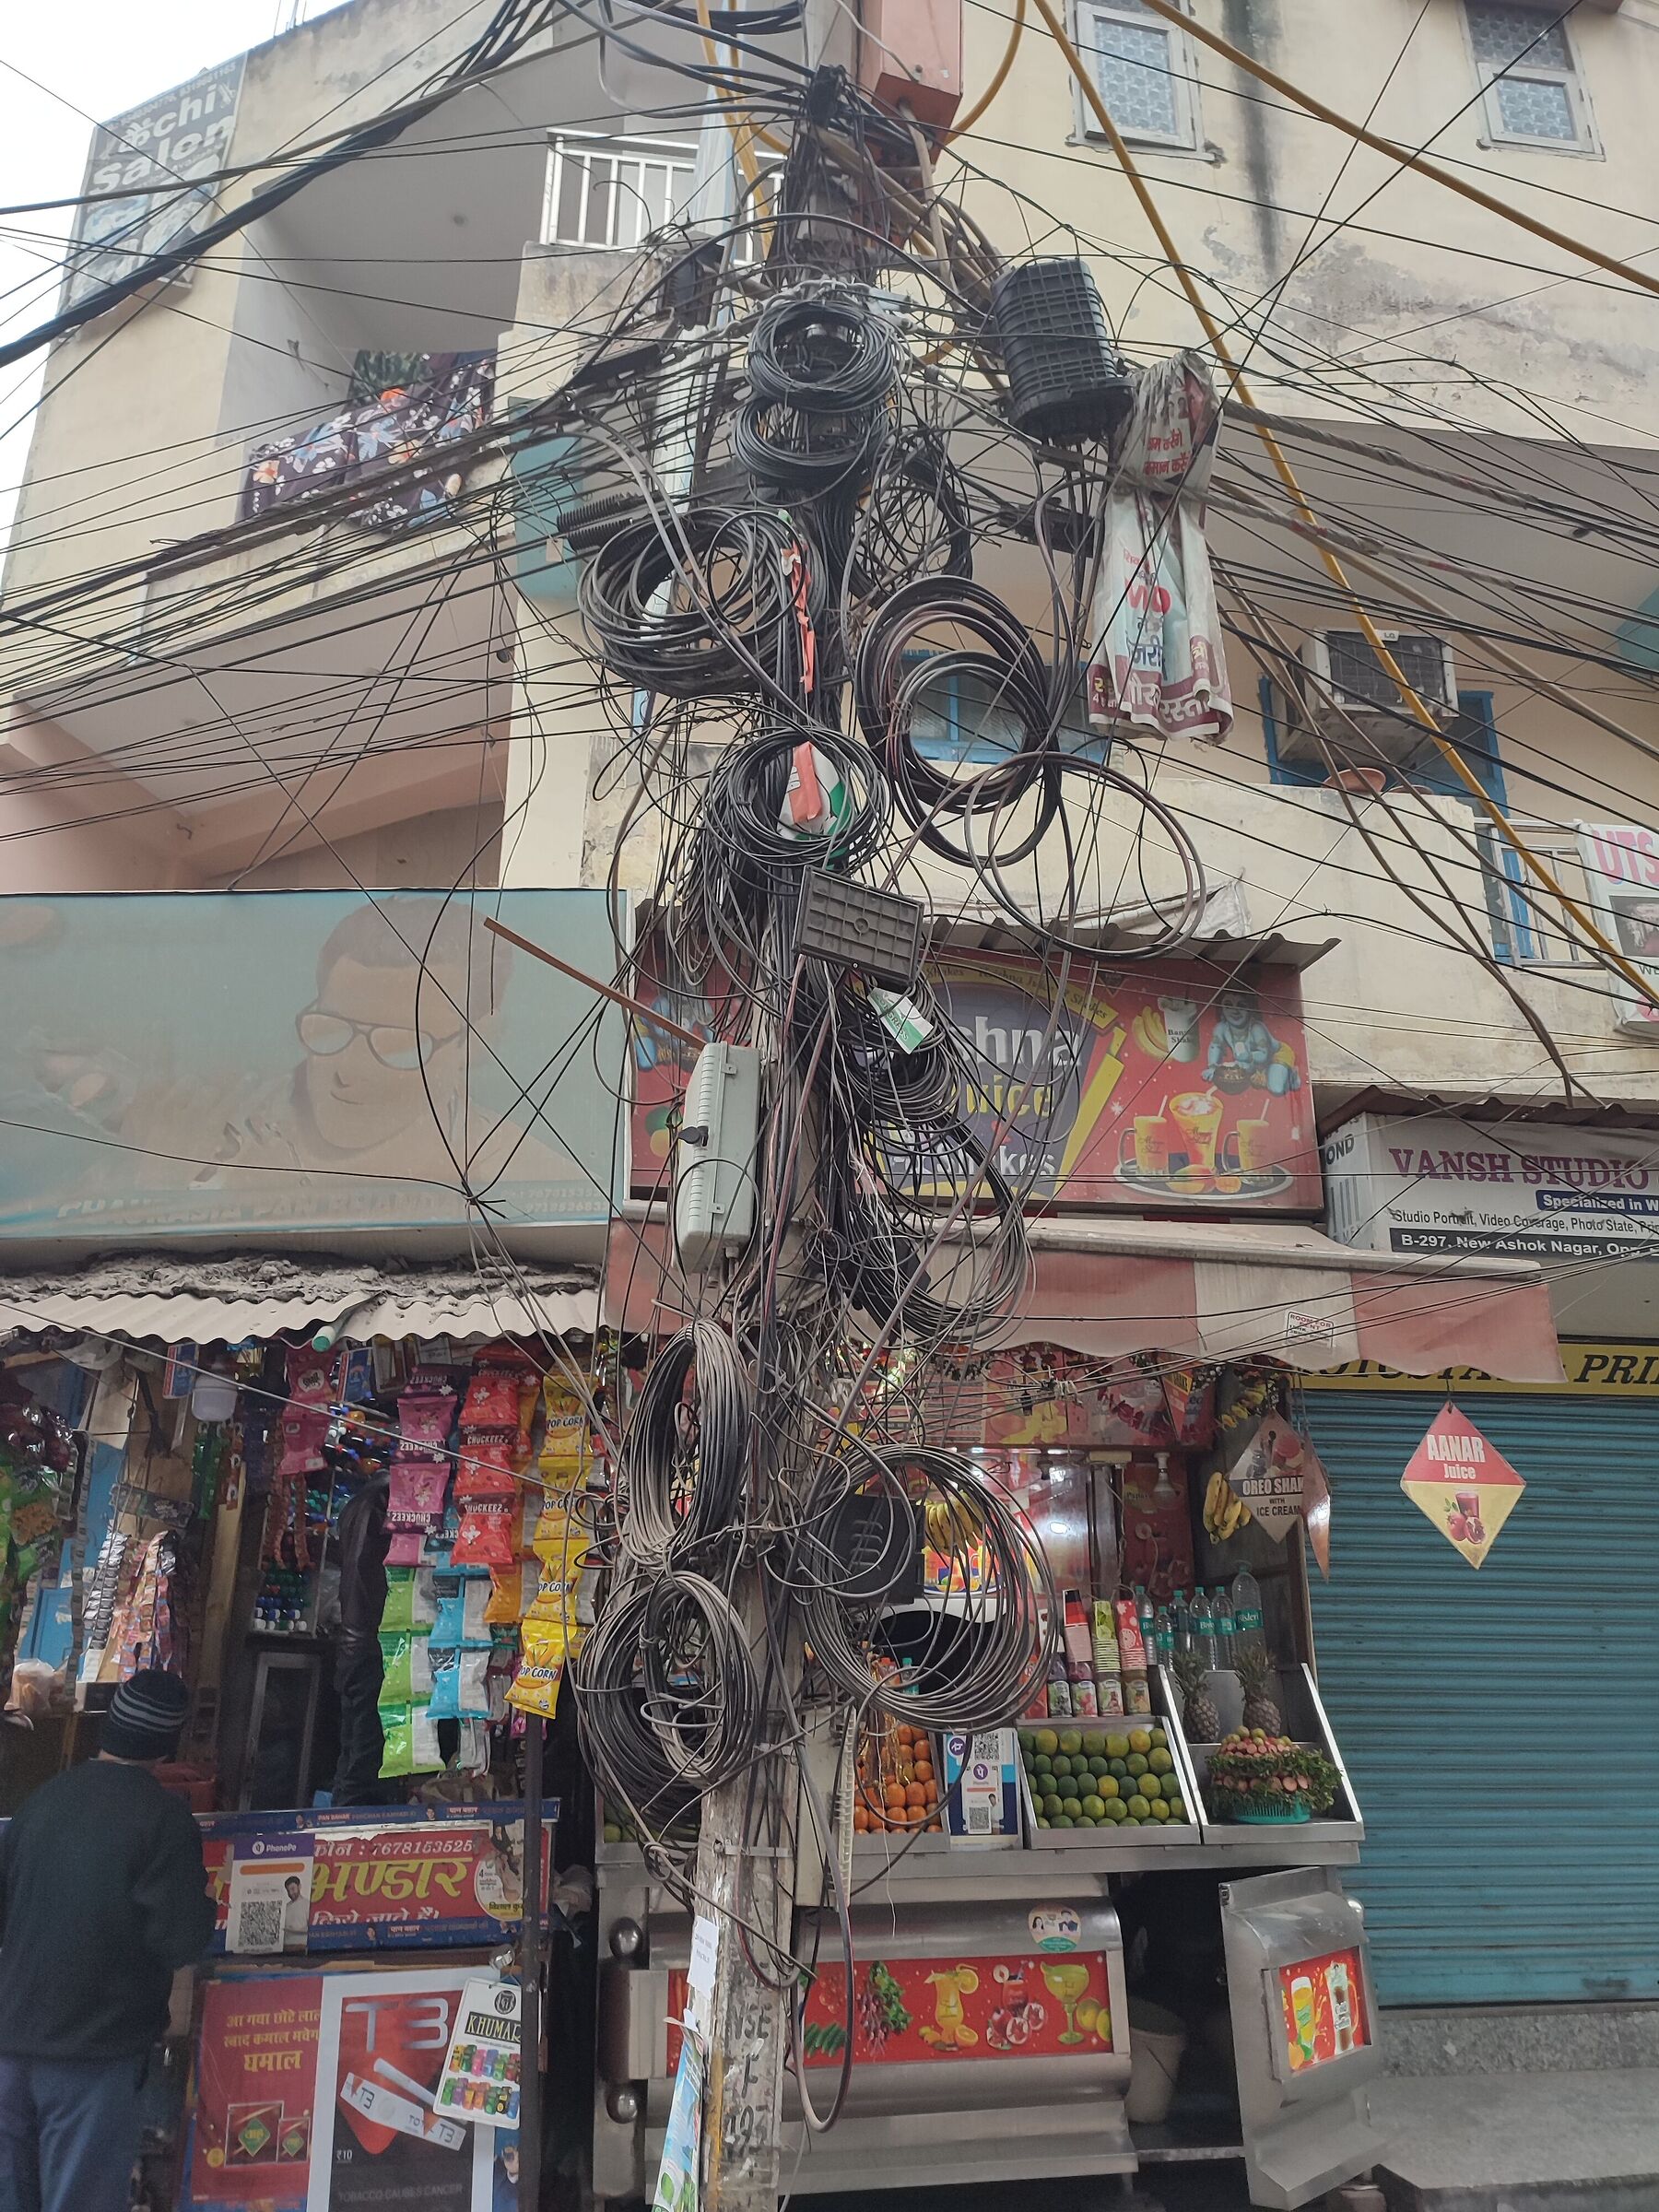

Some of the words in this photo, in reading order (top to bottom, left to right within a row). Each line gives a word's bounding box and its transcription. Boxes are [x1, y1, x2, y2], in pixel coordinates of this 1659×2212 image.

[88, 115, 235, 195] Salon
[1592, 830, 1659, 885] UTS
[1389, 1148, 1513, 1183] VANSH
[1521, 1154, 1649, 1190] STUDIO
[1543, 1194, 1625, 1209] Specialized
[1630, 1198, 1642, 1211] in
[1395, 1209, 1430, 1223] Studio
[1479, 1213, 1511, 1227] Video
[1513, 1215, 1569, 1232] Coverage,
[1571, 1217, 1605, 1231] Photo
[1606, 1218, 1638, 1234] State,
[1456, 1236, 1491, 1249] New
[1495, 1239, 1547, 1253] Ashok
[1550, 1241, 1602, 1256] Nagar,
[466, 1434, 505, 1445] CHUCKEEZ
[1427, 1434, 1486, 1463] AANAR
[1443, 1464, 1477, 1479] Juice
[1242, 1478, 1272, 1495] OREO
[391, 1512, 431, 1523] CHUCKEEZ
[1256, 1507, 1270, 1516] ICE
[531, 1666, 557, 1680] CORN
[265, 1842, 297, 1853] PhonePe
[345, 1997, 449, 2053] T3
[253, 2031, 290, 2045] कमाल
